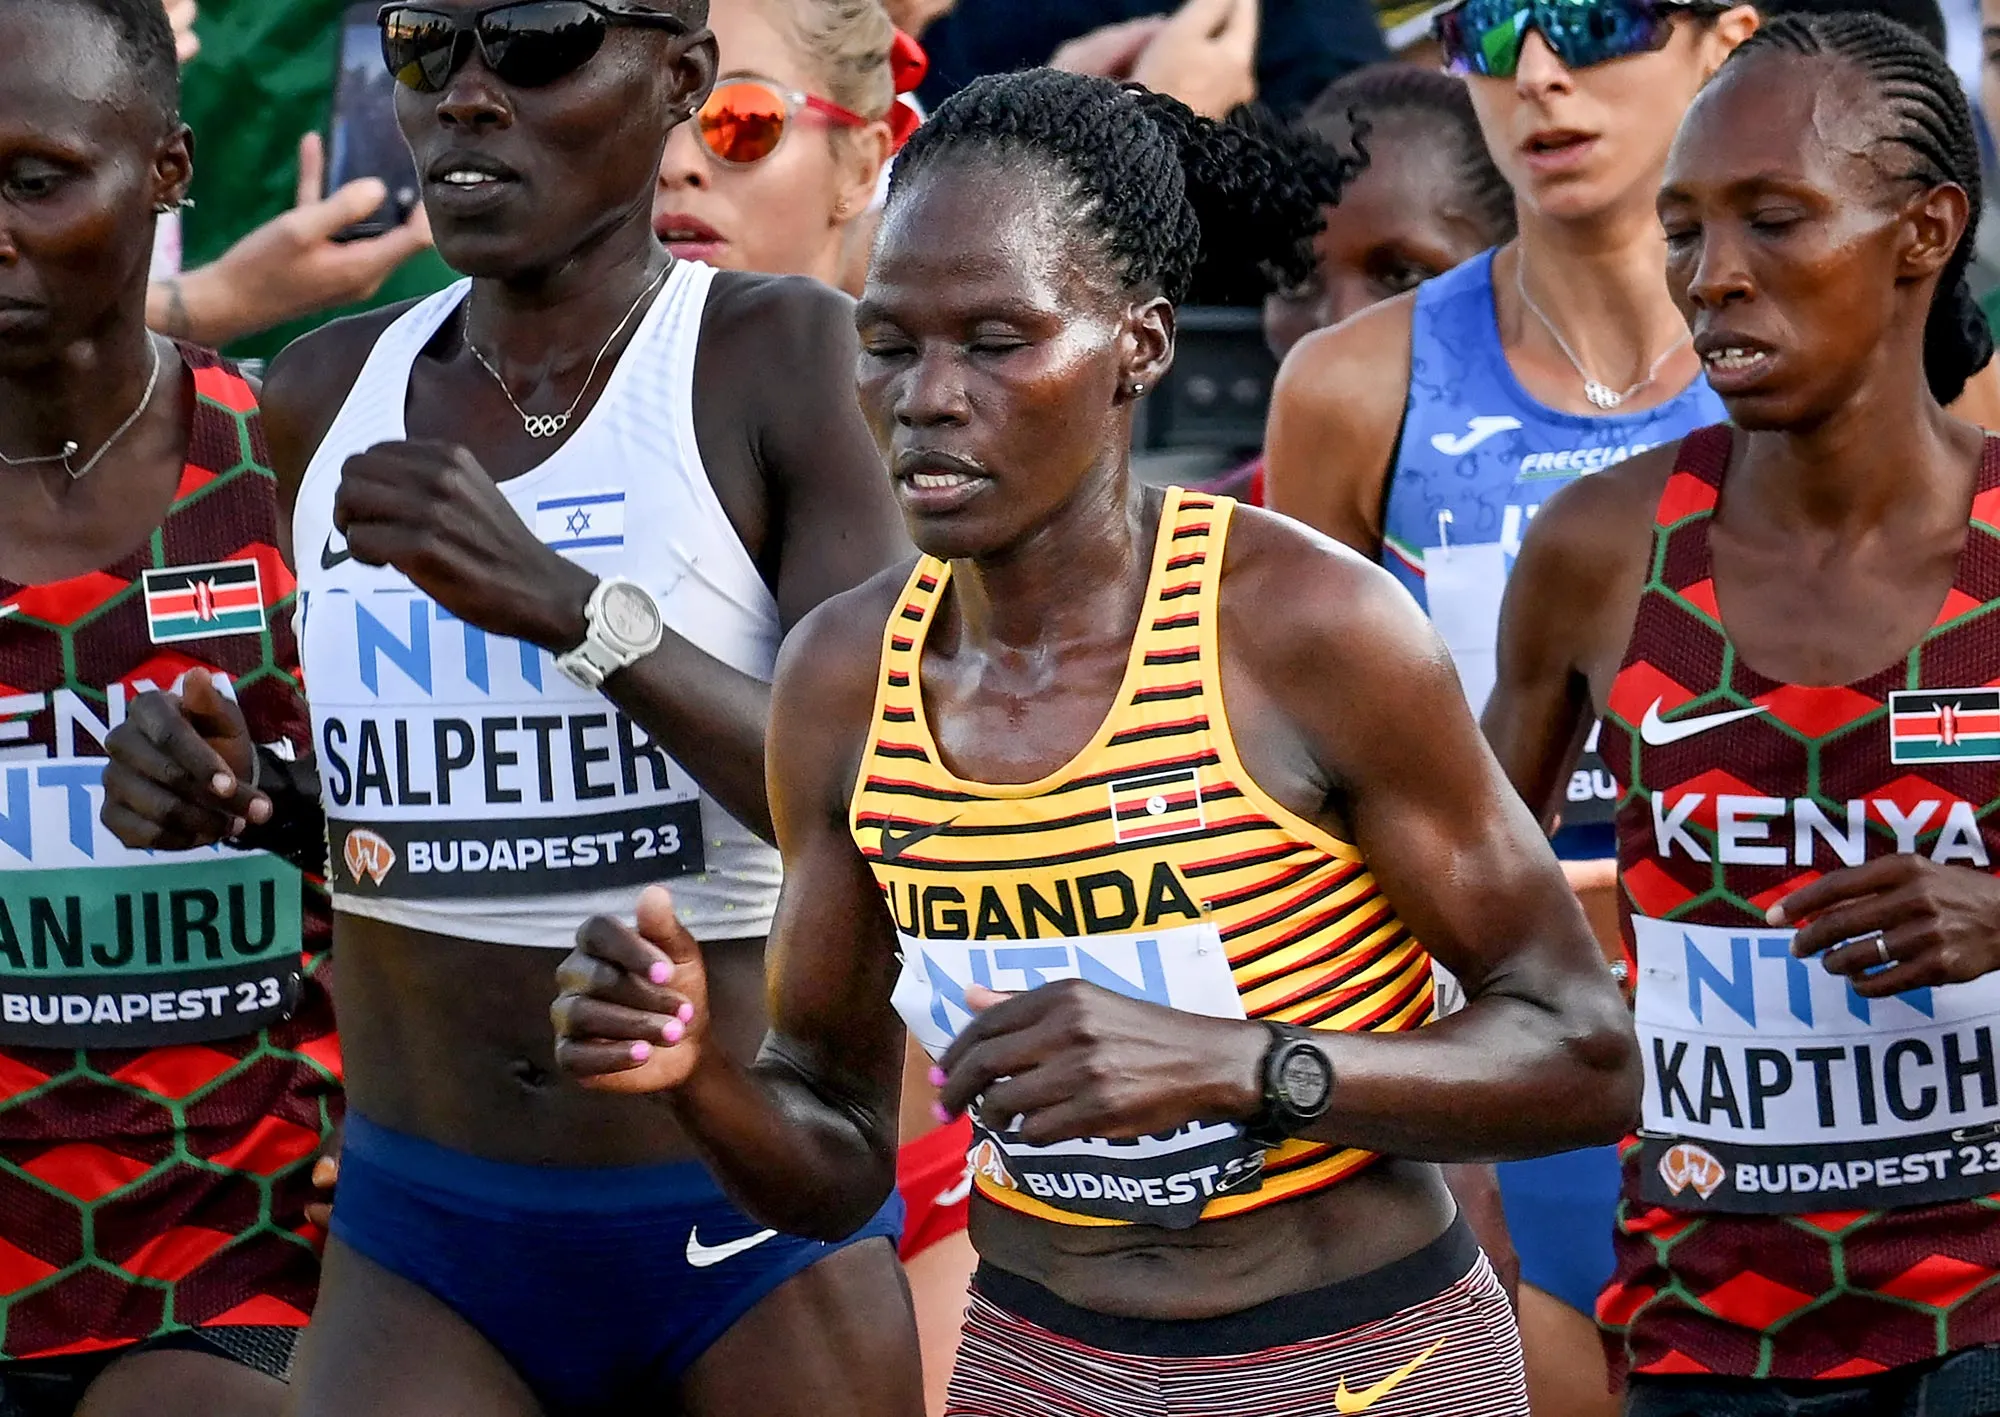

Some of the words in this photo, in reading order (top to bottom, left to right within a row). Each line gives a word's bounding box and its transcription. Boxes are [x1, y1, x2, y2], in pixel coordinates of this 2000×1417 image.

[1519, 441, 1663, 475] FRECCIA
[355, 599, 543, 696] NT
[323, 713, 671, 808] SALPETER
[407, 832, 624, 874] BUDAPEST
[631, 824, 682, 860] 23
[1652, 791, 1990, 867] KENYA
[889, 861, 1199, 941] UGANDA
[2, 985, 230, 1025] BUDAPEST
[235, 977, 281, 1013] 23
[1653, 1026, 1998, 1130] KAPTICH
[1023, 1165, 1220, 1207] BUDAPEST
[1735, 1149, 1953, 1195] BUDAPEST
[1957, 1141, 2000, 1177] 23
